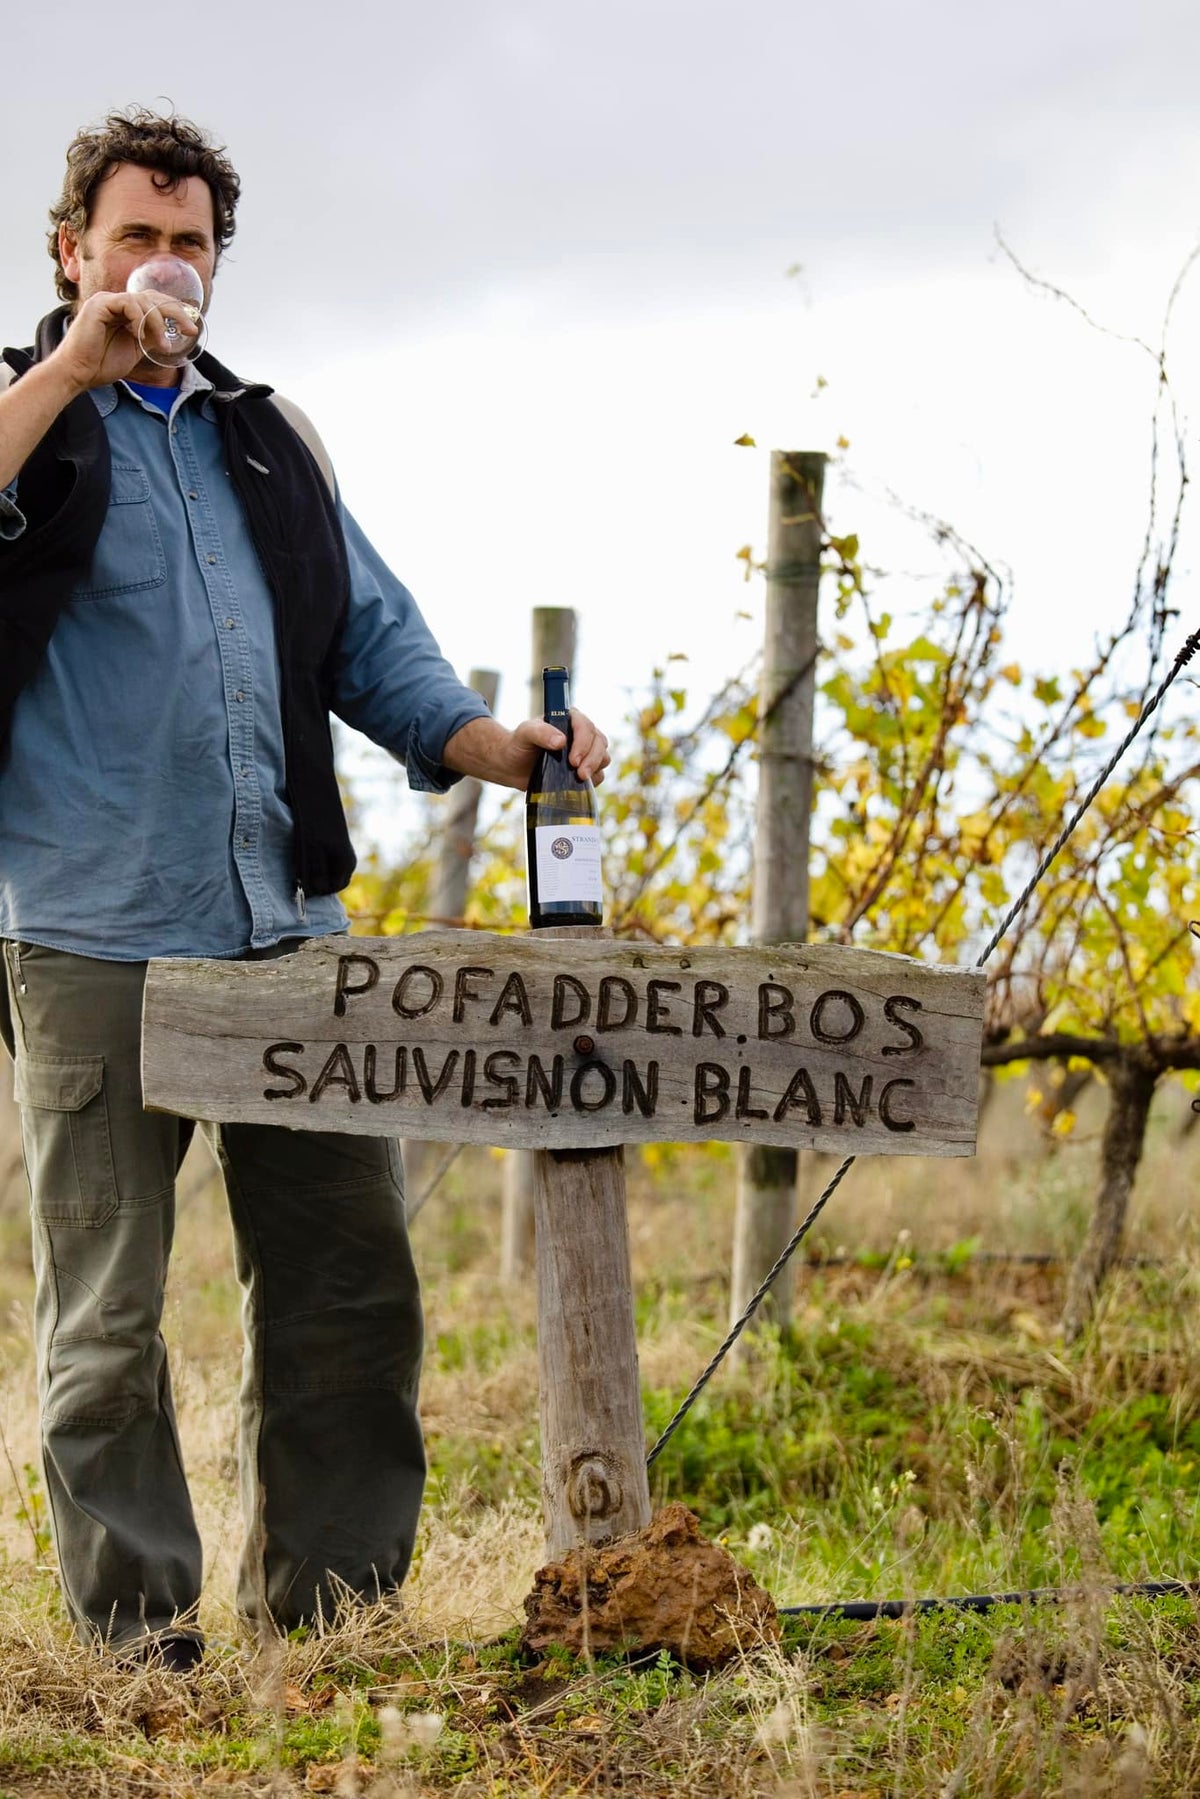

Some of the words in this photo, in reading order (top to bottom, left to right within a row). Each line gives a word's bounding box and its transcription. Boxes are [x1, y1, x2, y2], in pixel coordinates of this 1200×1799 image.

[758, 982, 924, 1056] BOS
[263, 1042, 659, 1118] SAUVIGNON
[693, 1062, 915, 1132] BLANC
